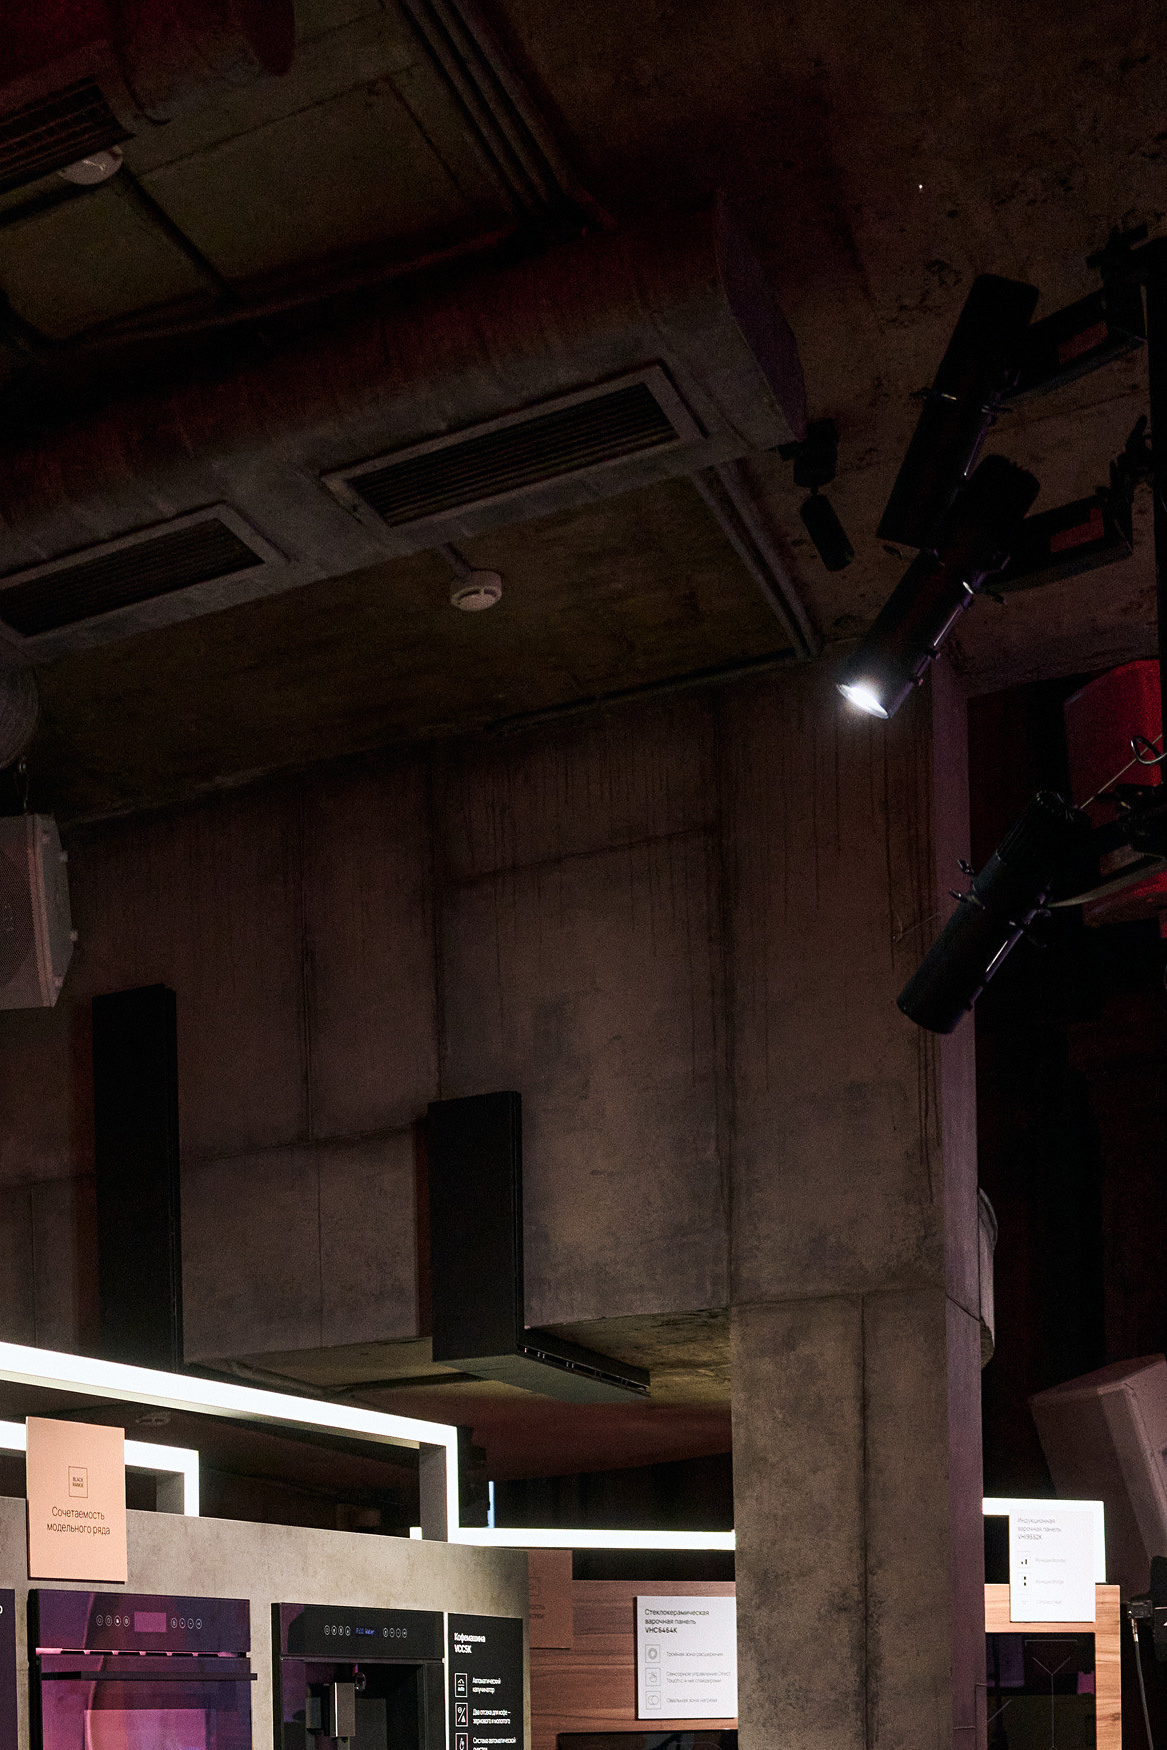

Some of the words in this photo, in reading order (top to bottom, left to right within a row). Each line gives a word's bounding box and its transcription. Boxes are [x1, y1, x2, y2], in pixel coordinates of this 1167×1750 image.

[51, 1506, 105, 1520] Сочетаемость
[47, 1523, 92, 1534] модельного
[92, 1526, 111, 1538] ряда
[644, 1608, 710, 1617] Стеклокерамическая
[454, 1632, 486, 1643] Кофемашина
